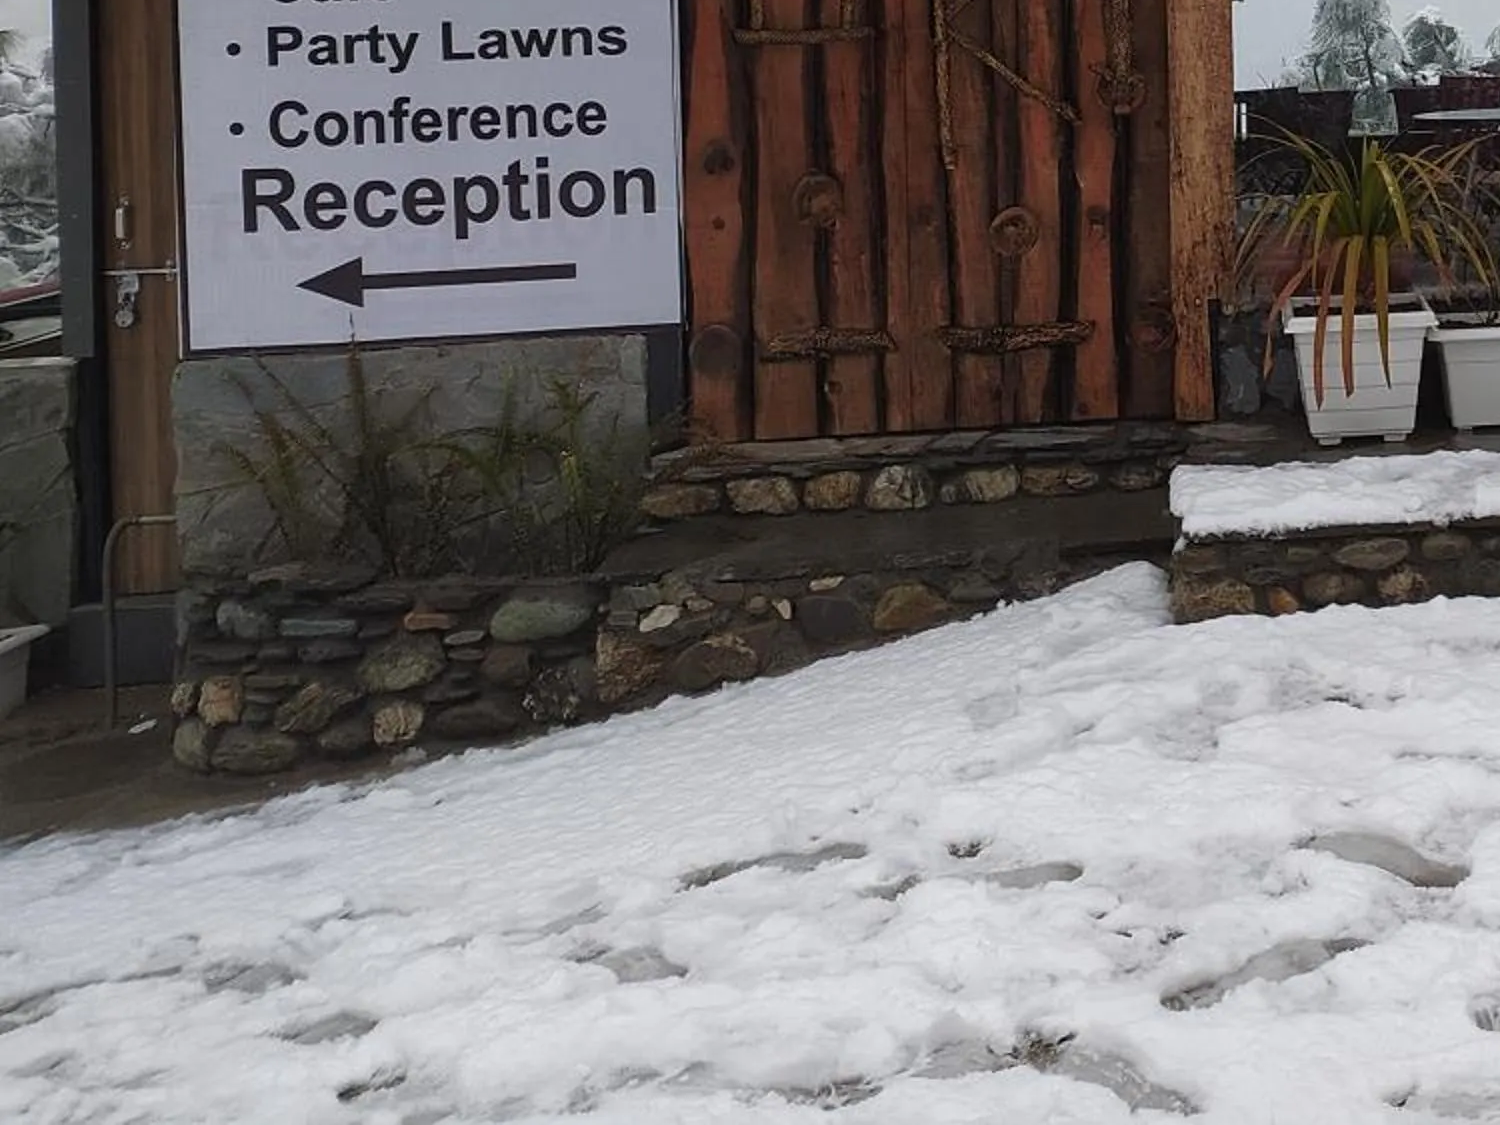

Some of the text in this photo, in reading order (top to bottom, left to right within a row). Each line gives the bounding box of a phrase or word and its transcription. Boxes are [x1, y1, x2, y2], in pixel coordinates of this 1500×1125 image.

[266, 20, 628, 74] Party Lawns
[268, 96, 608, 149] Conference
[241, 155, 657, 241] Reception
